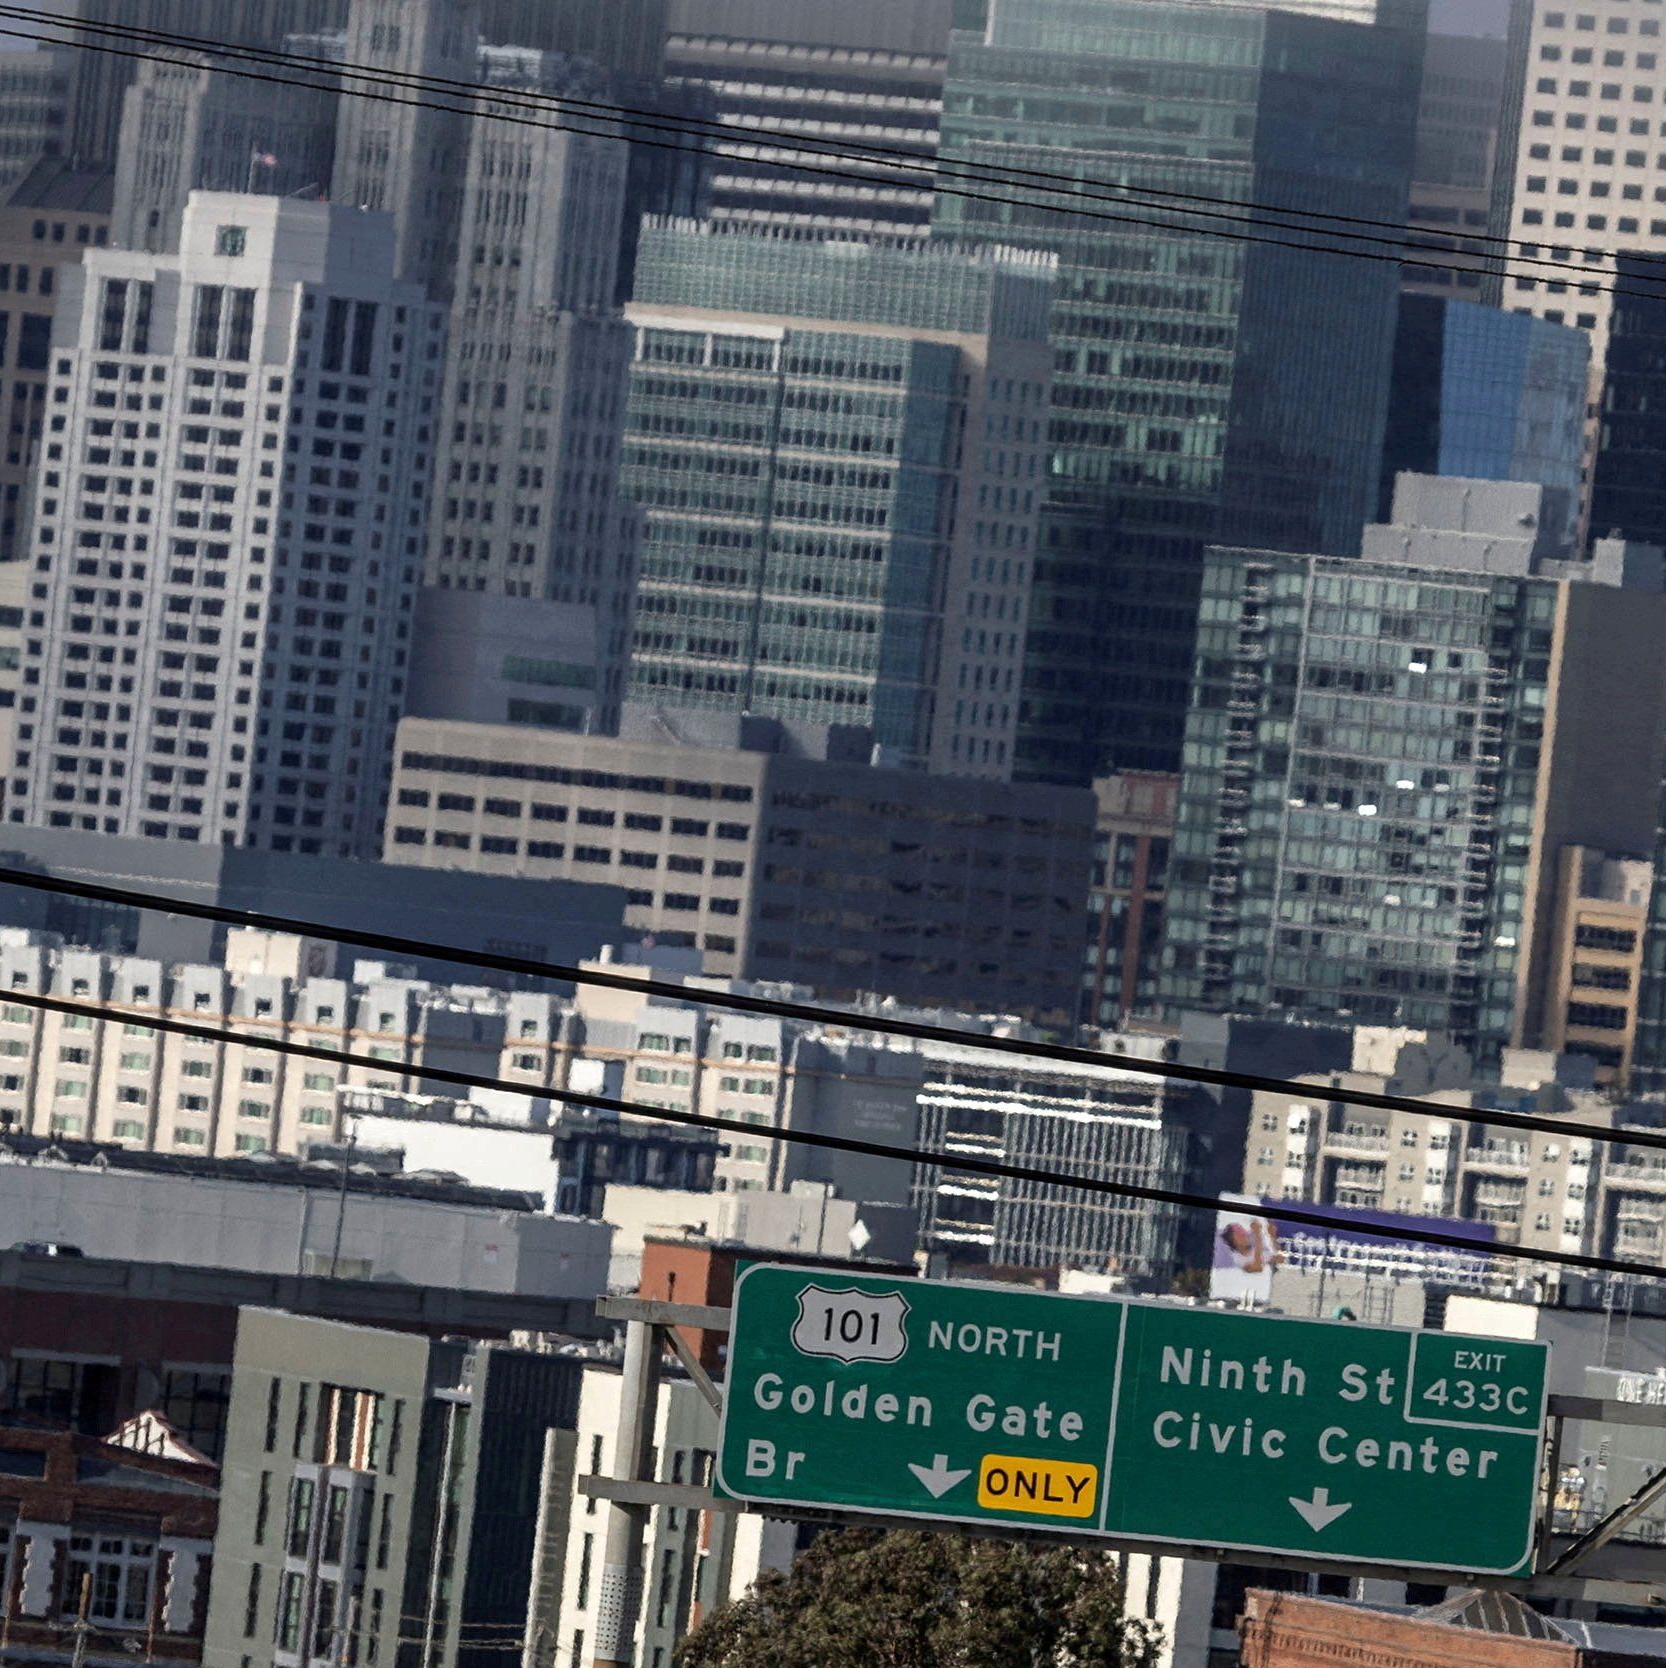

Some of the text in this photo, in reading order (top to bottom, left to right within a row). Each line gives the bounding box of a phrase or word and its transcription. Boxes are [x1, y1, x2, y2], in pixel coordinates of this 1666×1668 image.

[824, 1307, 1062, 1361] 101 NORTH
[1454, 1350, 1507, 1373] EXIT
[1160, 1345, 1395, 1405] Ninth St
[1422, 1377, 1529, 1416] 433C
[753, 1372, 1084, 1441] Golden Gate
[745, 1439, 1092, 1504] Br ONLY
[1153, 1410, 1499, 1479] Civic Center
